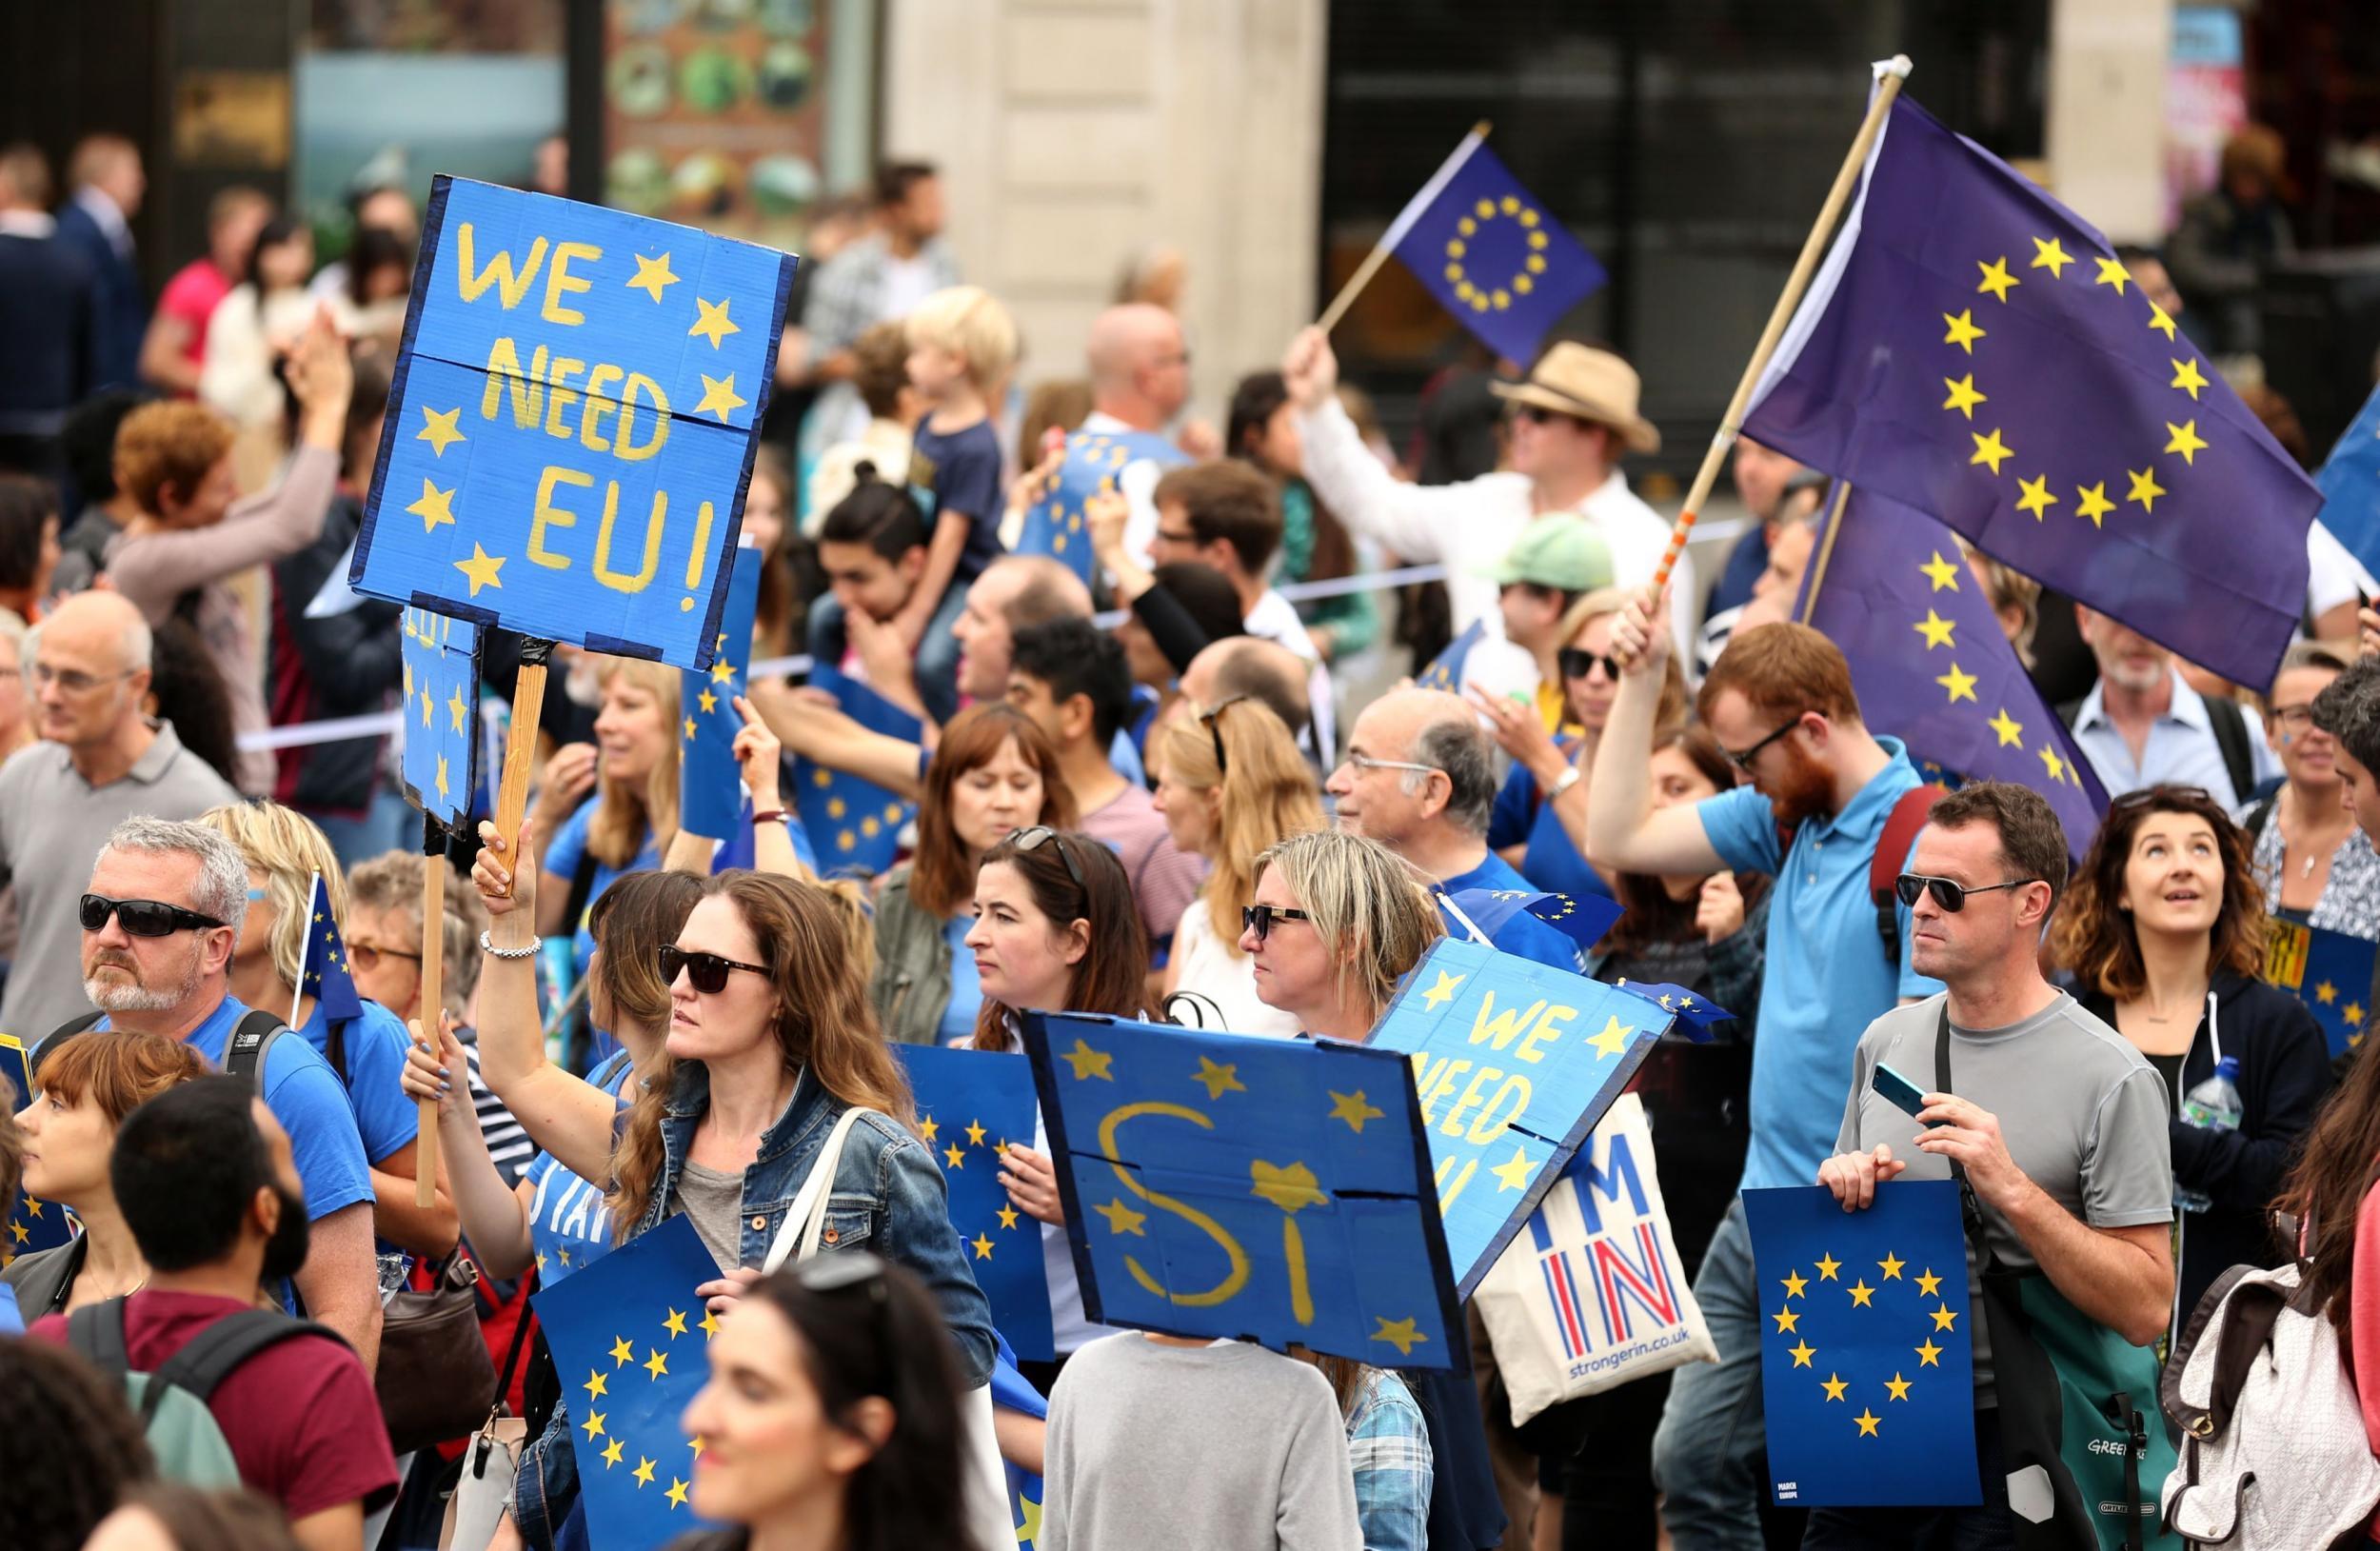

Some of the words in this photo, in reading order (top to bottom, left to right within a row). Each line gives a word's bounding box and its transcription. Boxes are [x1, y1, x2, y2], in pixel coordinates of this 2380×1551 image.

[458, 222, 603, 326] WE
[482, 337, 671, 461] NEED
[527, 467, 714, 612] EU!
[1469, 991, 1578, 1064] WE
[1540, 1222, 1683, 1360] IN
[1570, 1327, 1690, 1379] strongerin.co.uk
